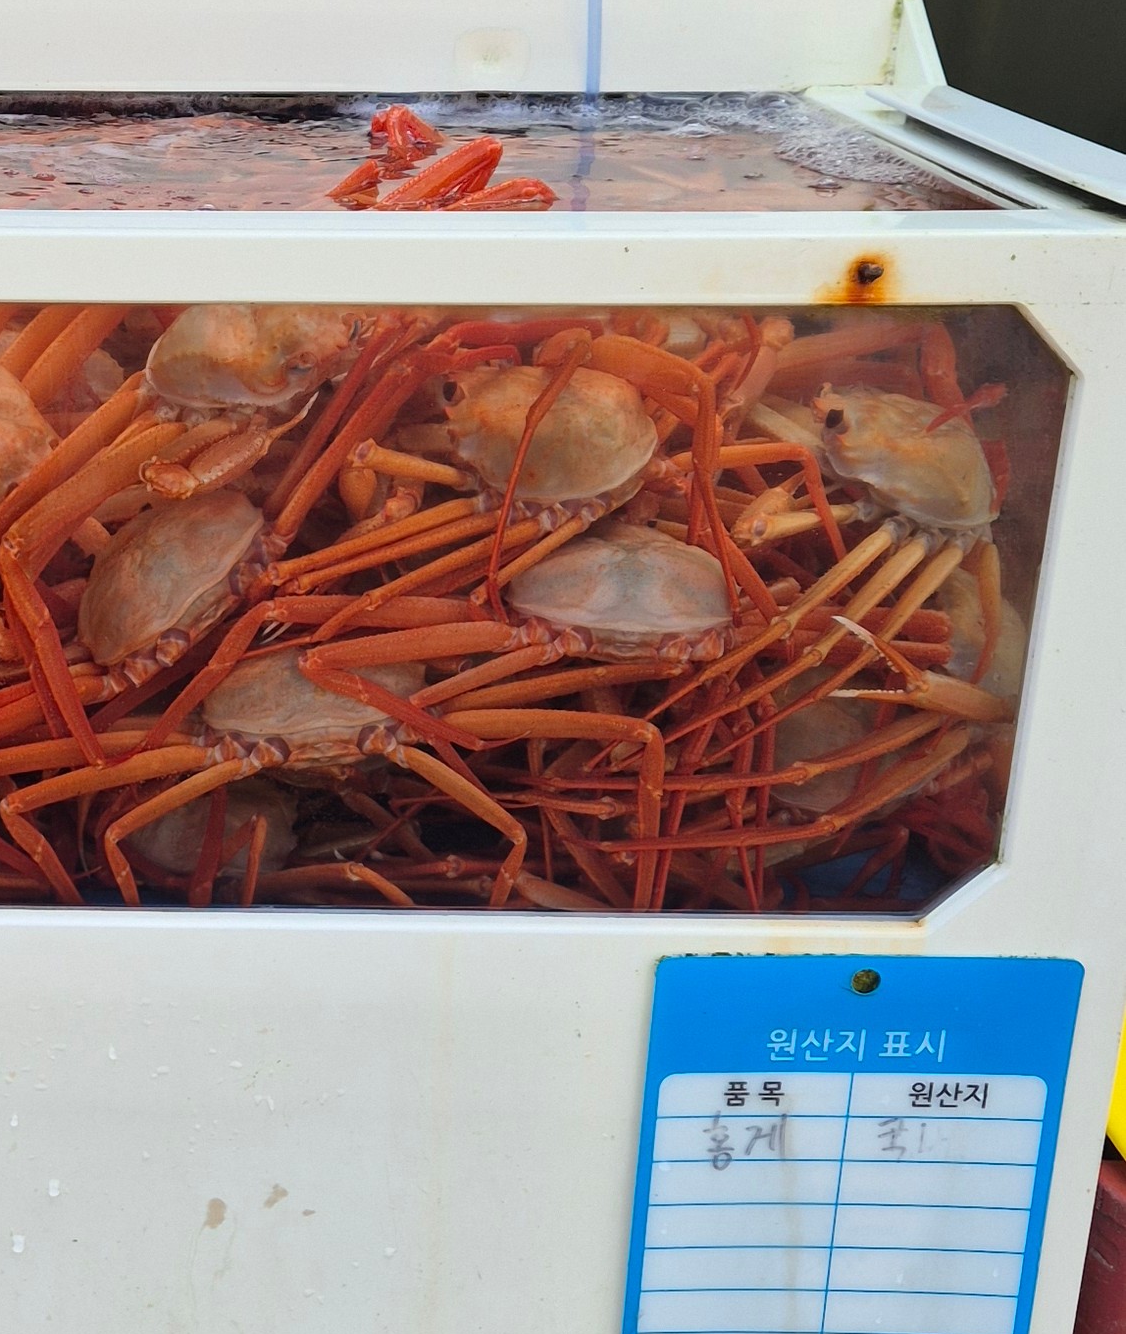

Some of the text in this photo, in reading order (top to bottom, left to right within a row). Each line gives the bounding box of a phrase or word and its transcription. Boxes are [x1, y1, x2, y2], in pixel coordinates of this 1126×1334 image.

[766, 1028, 947, 1063] 원산지 표시
[908, 1081, 989, 1109] 원산지
[702, 1110, 788, 1171] 홍게
